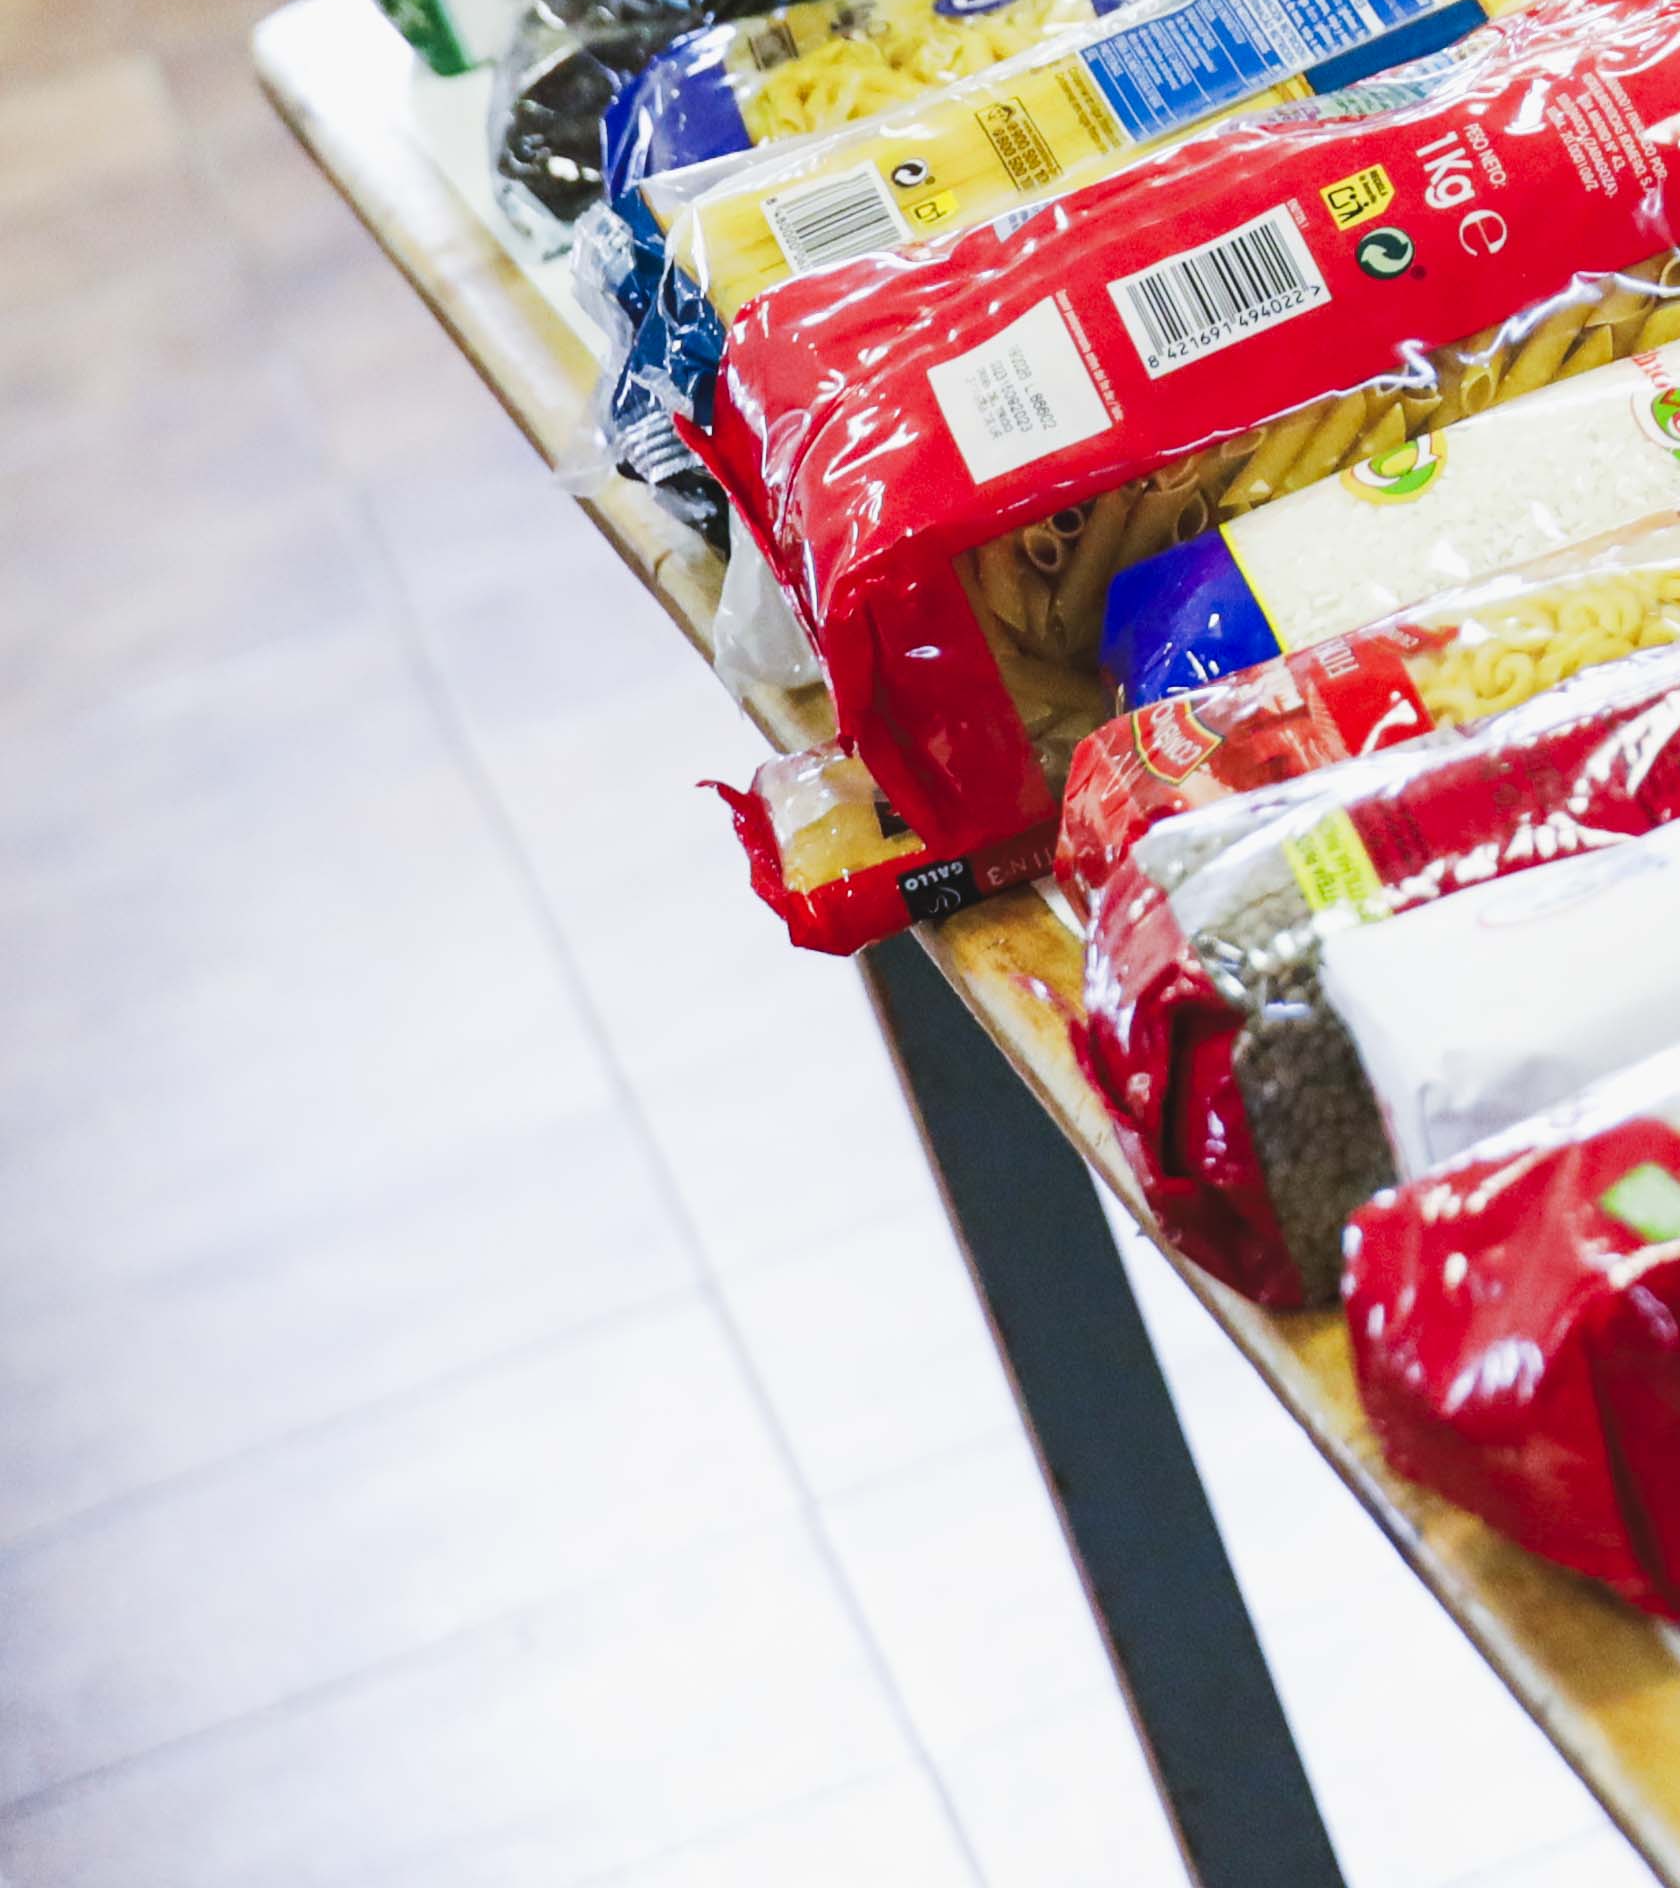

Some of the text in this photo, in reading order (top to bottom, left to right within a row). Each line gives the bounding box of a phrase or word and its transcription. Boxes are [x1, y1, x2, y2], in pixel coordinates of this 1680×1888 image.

[1462, 122, 1512, 190] PESO NETO:
[1146, 284, 1306, 371] 8 421691 494022
[904, 860, 965, 892] GALLO
